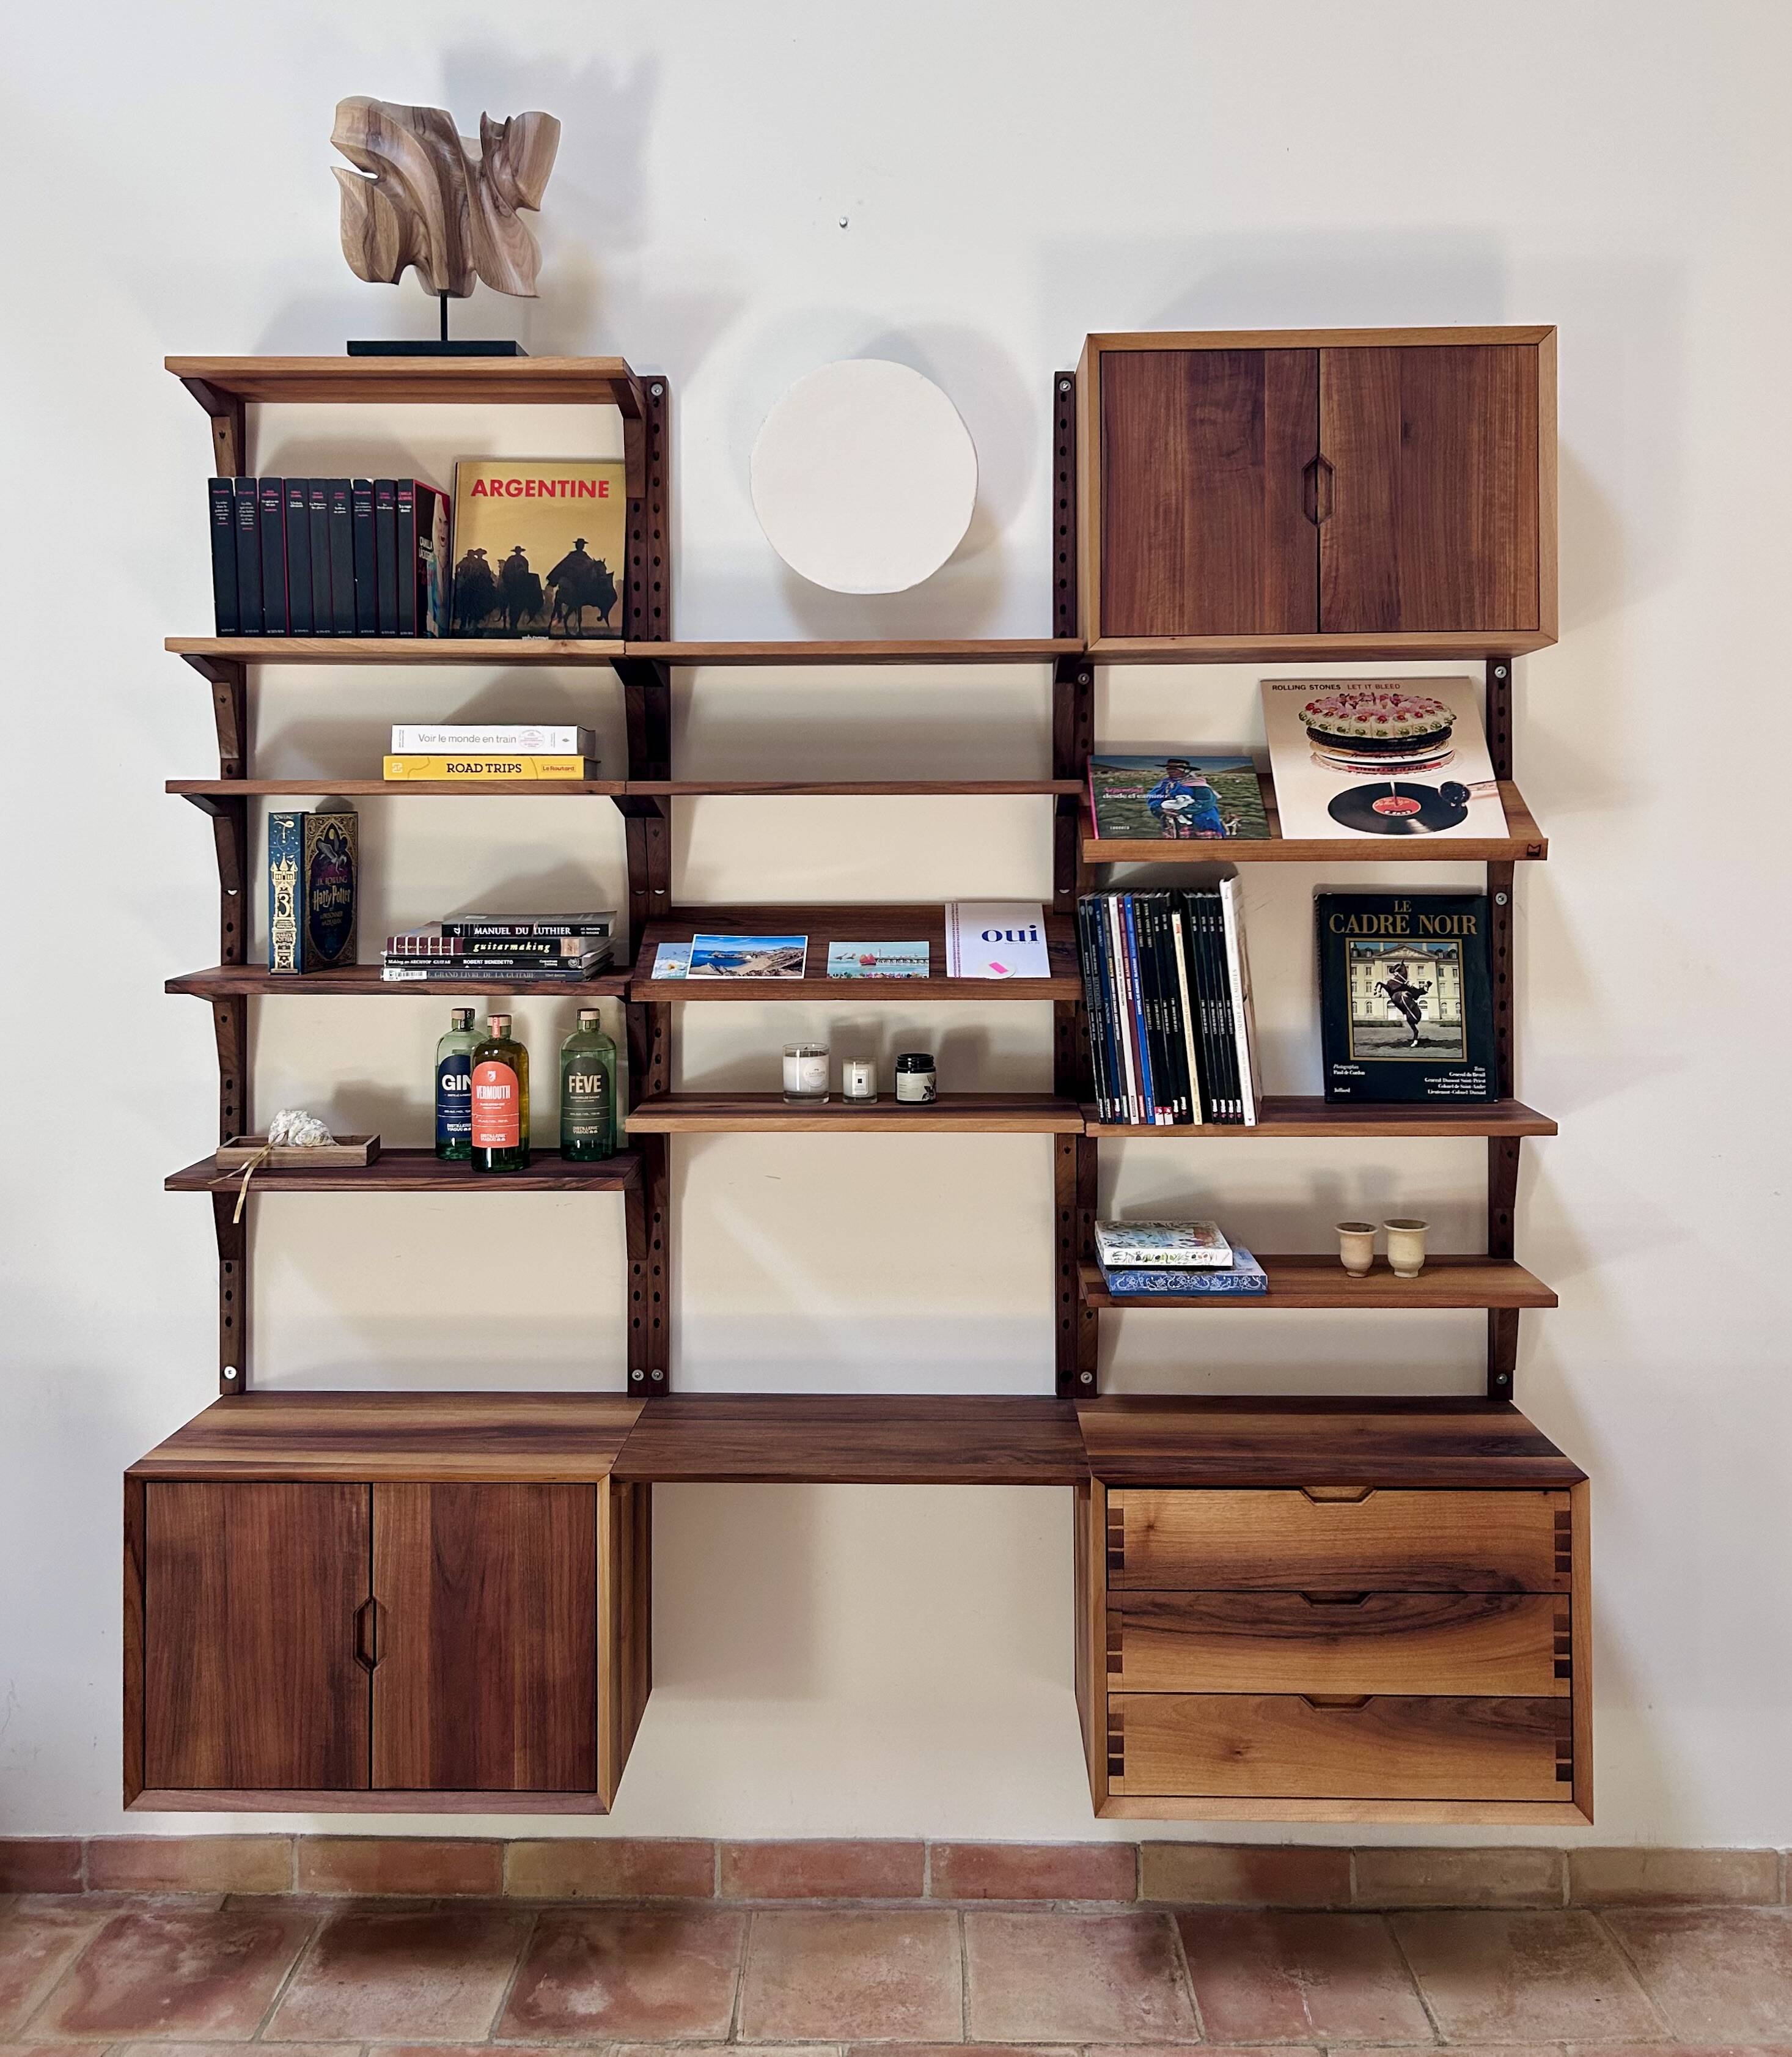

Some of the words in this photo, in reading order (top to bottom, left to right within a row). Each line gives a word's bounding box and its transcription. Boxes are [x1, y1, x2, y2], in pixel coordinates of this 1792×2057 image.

[471, 479, 609, 498] ARGENTINE
[418, 734, 436, 743] Voir
[438, 734, 446, 743] le
[448, 734, 481, 743] monde
[496, 734, 516, 743] train
[447, 764, 483, 773] ROAD
[486, 764, 522, 773] TRIPS
[279, 893, 290, 917] 3
[313, 889, 332, 911] Harry
[332, 885, 351, 908] Potter
[1394, 900, 1412, 913] LE
[533, 927, 571, 935] LUTHIER
[982, 924, 1039, 942] oui
[1329, 914, 1410, 935] CADRE
[1419, 914, 1477, 935] NOIR
[474, 941, 550, 954] guitarmaking
[442, 1074, 471, 1091] GIN
[568, 1072, 602, 1093] FÈVE
[476, 1084, 511, 1100] VERMOUTH
